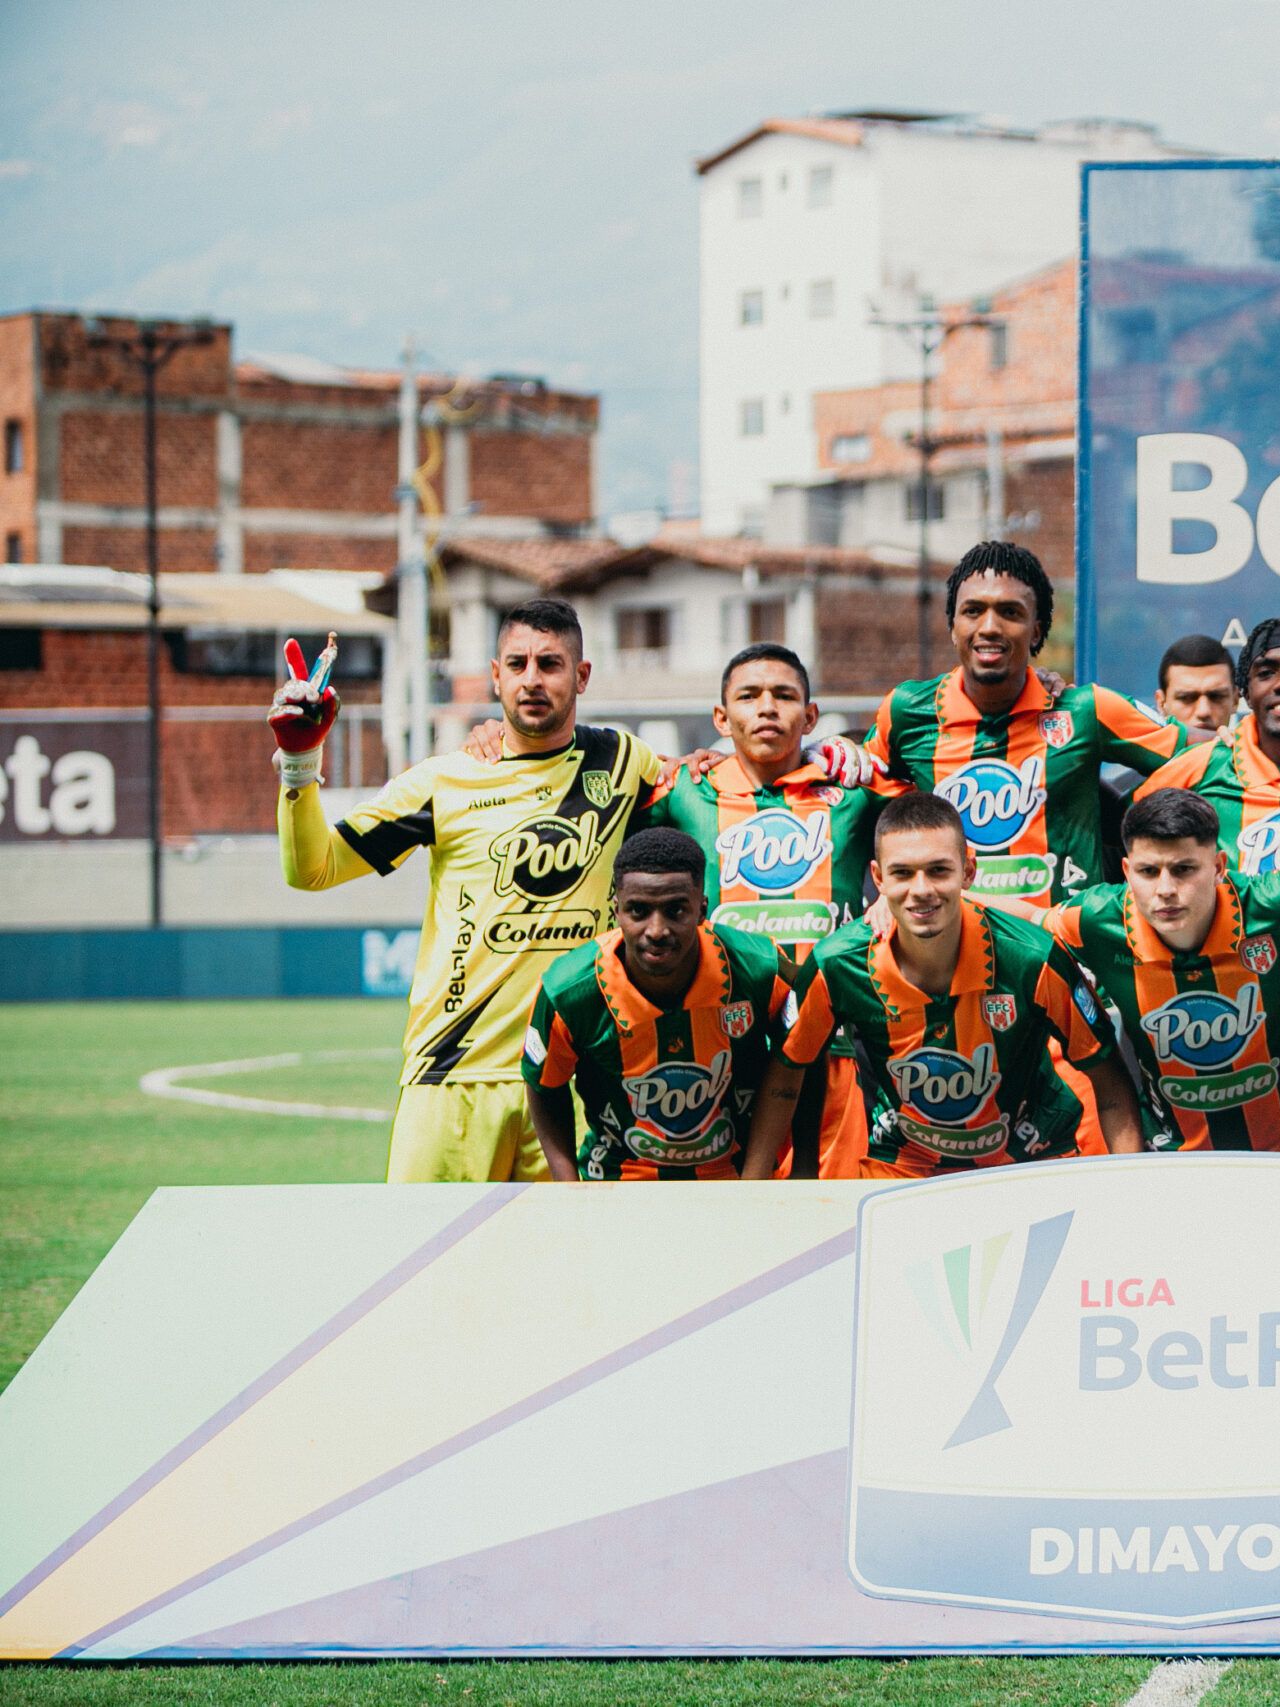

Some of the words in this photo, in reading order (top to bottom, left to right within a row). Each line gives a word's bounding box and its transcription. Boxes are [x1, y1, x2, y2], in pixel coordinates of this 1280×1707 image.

[0, 734, 117, 835] ta
[494, 811, 599, 890] Pool
[720, 811, 829, 884] Pool
[974, 867, 1047, 889] lanta
[488, 921, 595, 943] Colanta
[1246, 943, 1270, 958] EFC
[725, 1009, 748, 1023] EFC
[986, 1003, 1011, 1014] EFC
[1144, 983, 1260, 1060] Pool
[625, 1051, 729, 1117] Pool
[889, 1043, 995, 1104] Pool
[1162, 1071, 1273, 1103] Colanta
[629, 1125, 732, 1160] Colanta
[901, 1118, 1003, 1151] Colanta
[1079, 1278, 1176, 1308] LIGA
